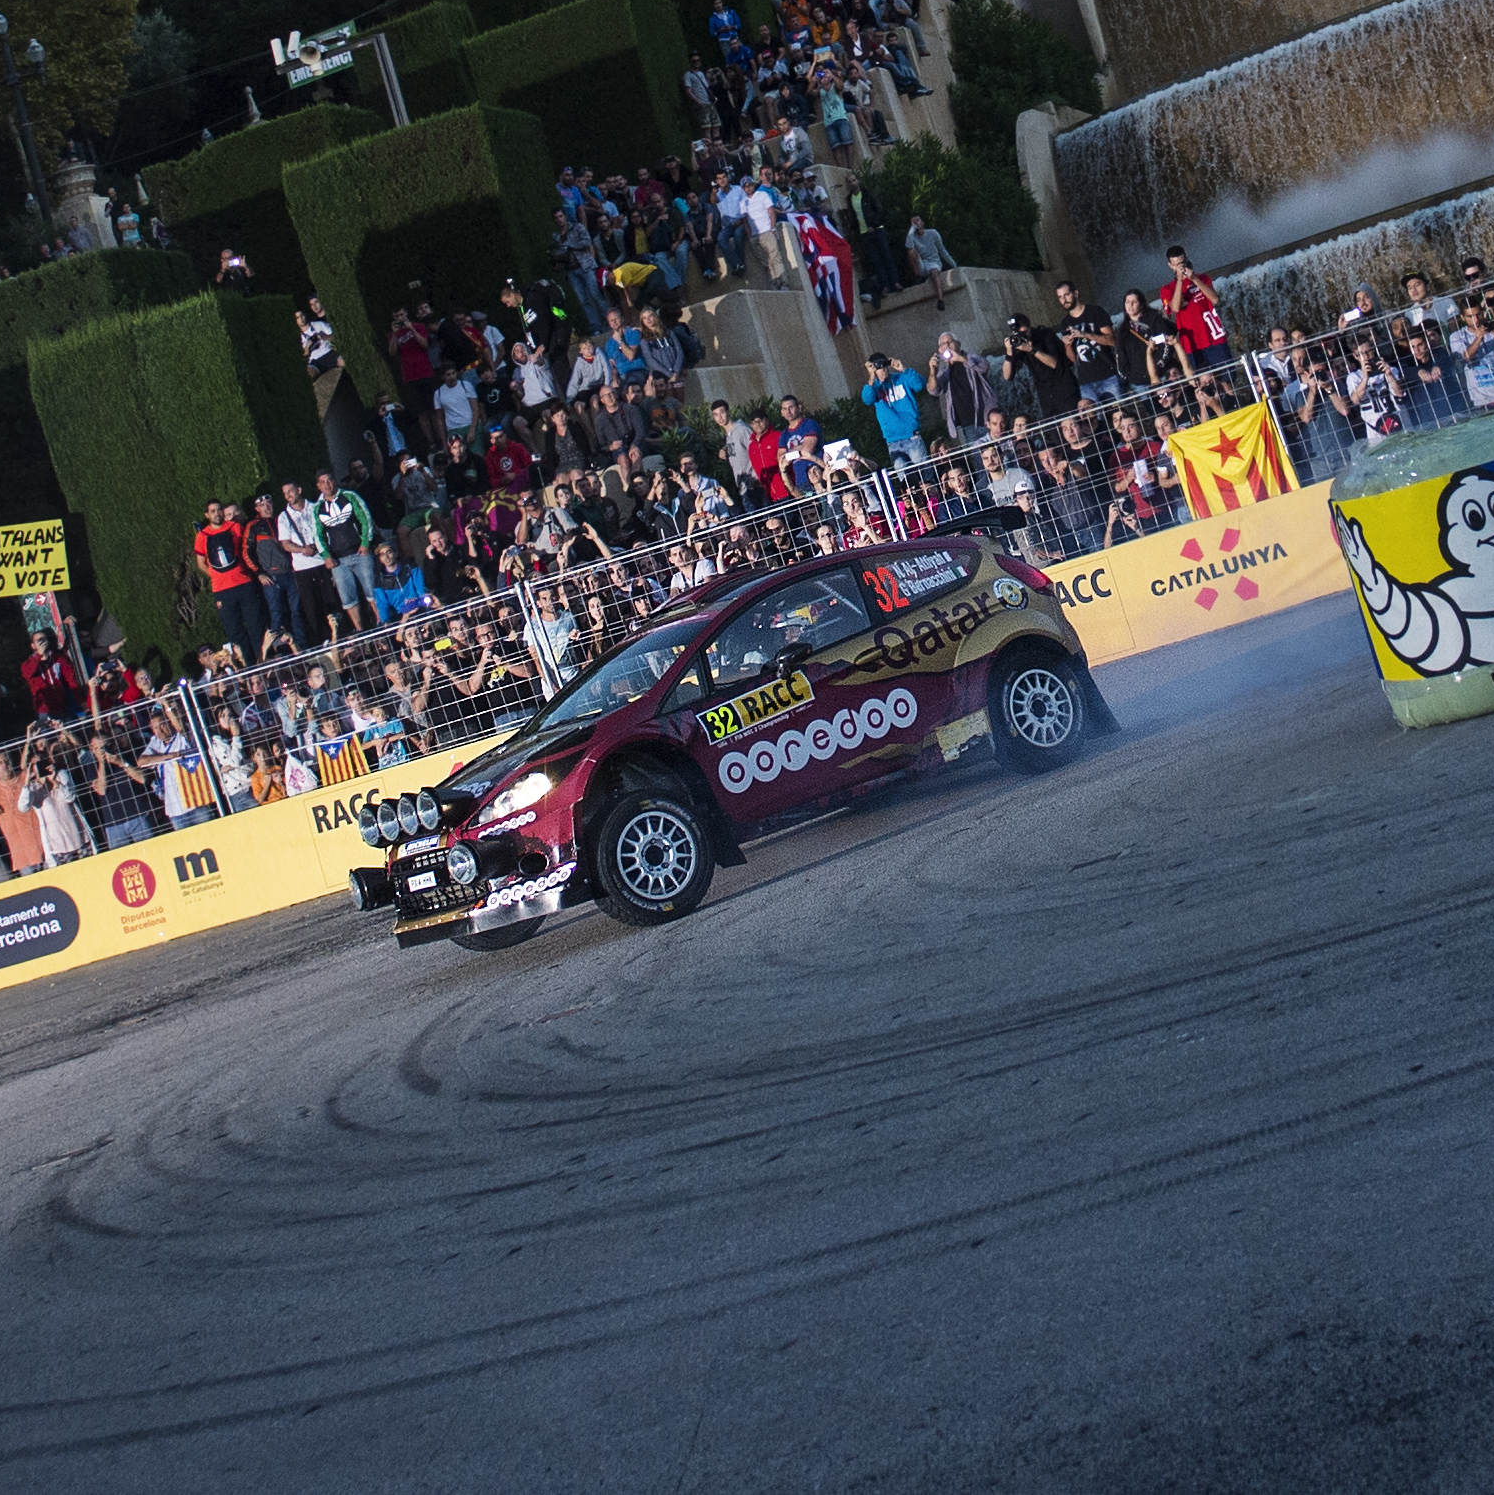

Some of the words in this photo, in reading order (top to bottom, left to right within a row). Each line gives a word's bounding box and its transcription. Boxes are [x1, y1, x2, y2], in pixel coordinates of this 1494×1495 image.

[15, 567, 66, 589] VOTE
[862, 566, 910, 612] 32
[1056, 568, 1112, 607] ACC
[1150, 543, 1288, 597] CATALUNYA
[873, 591, 990, 669] Qatar
[707, 706, 738, 739] 32
[741, 676, 804, 722] RACC
[722, 692, 914, 789] ooredoo
[173, 848, 219, 883] m
[182, 889, 190, 897] de
[192, 881, 224, 894] Catalunya
[39, 901, 56, 917] de
[120, 906, 164, 925] Diputació
[123, 917, 166, 934] Barcelona
